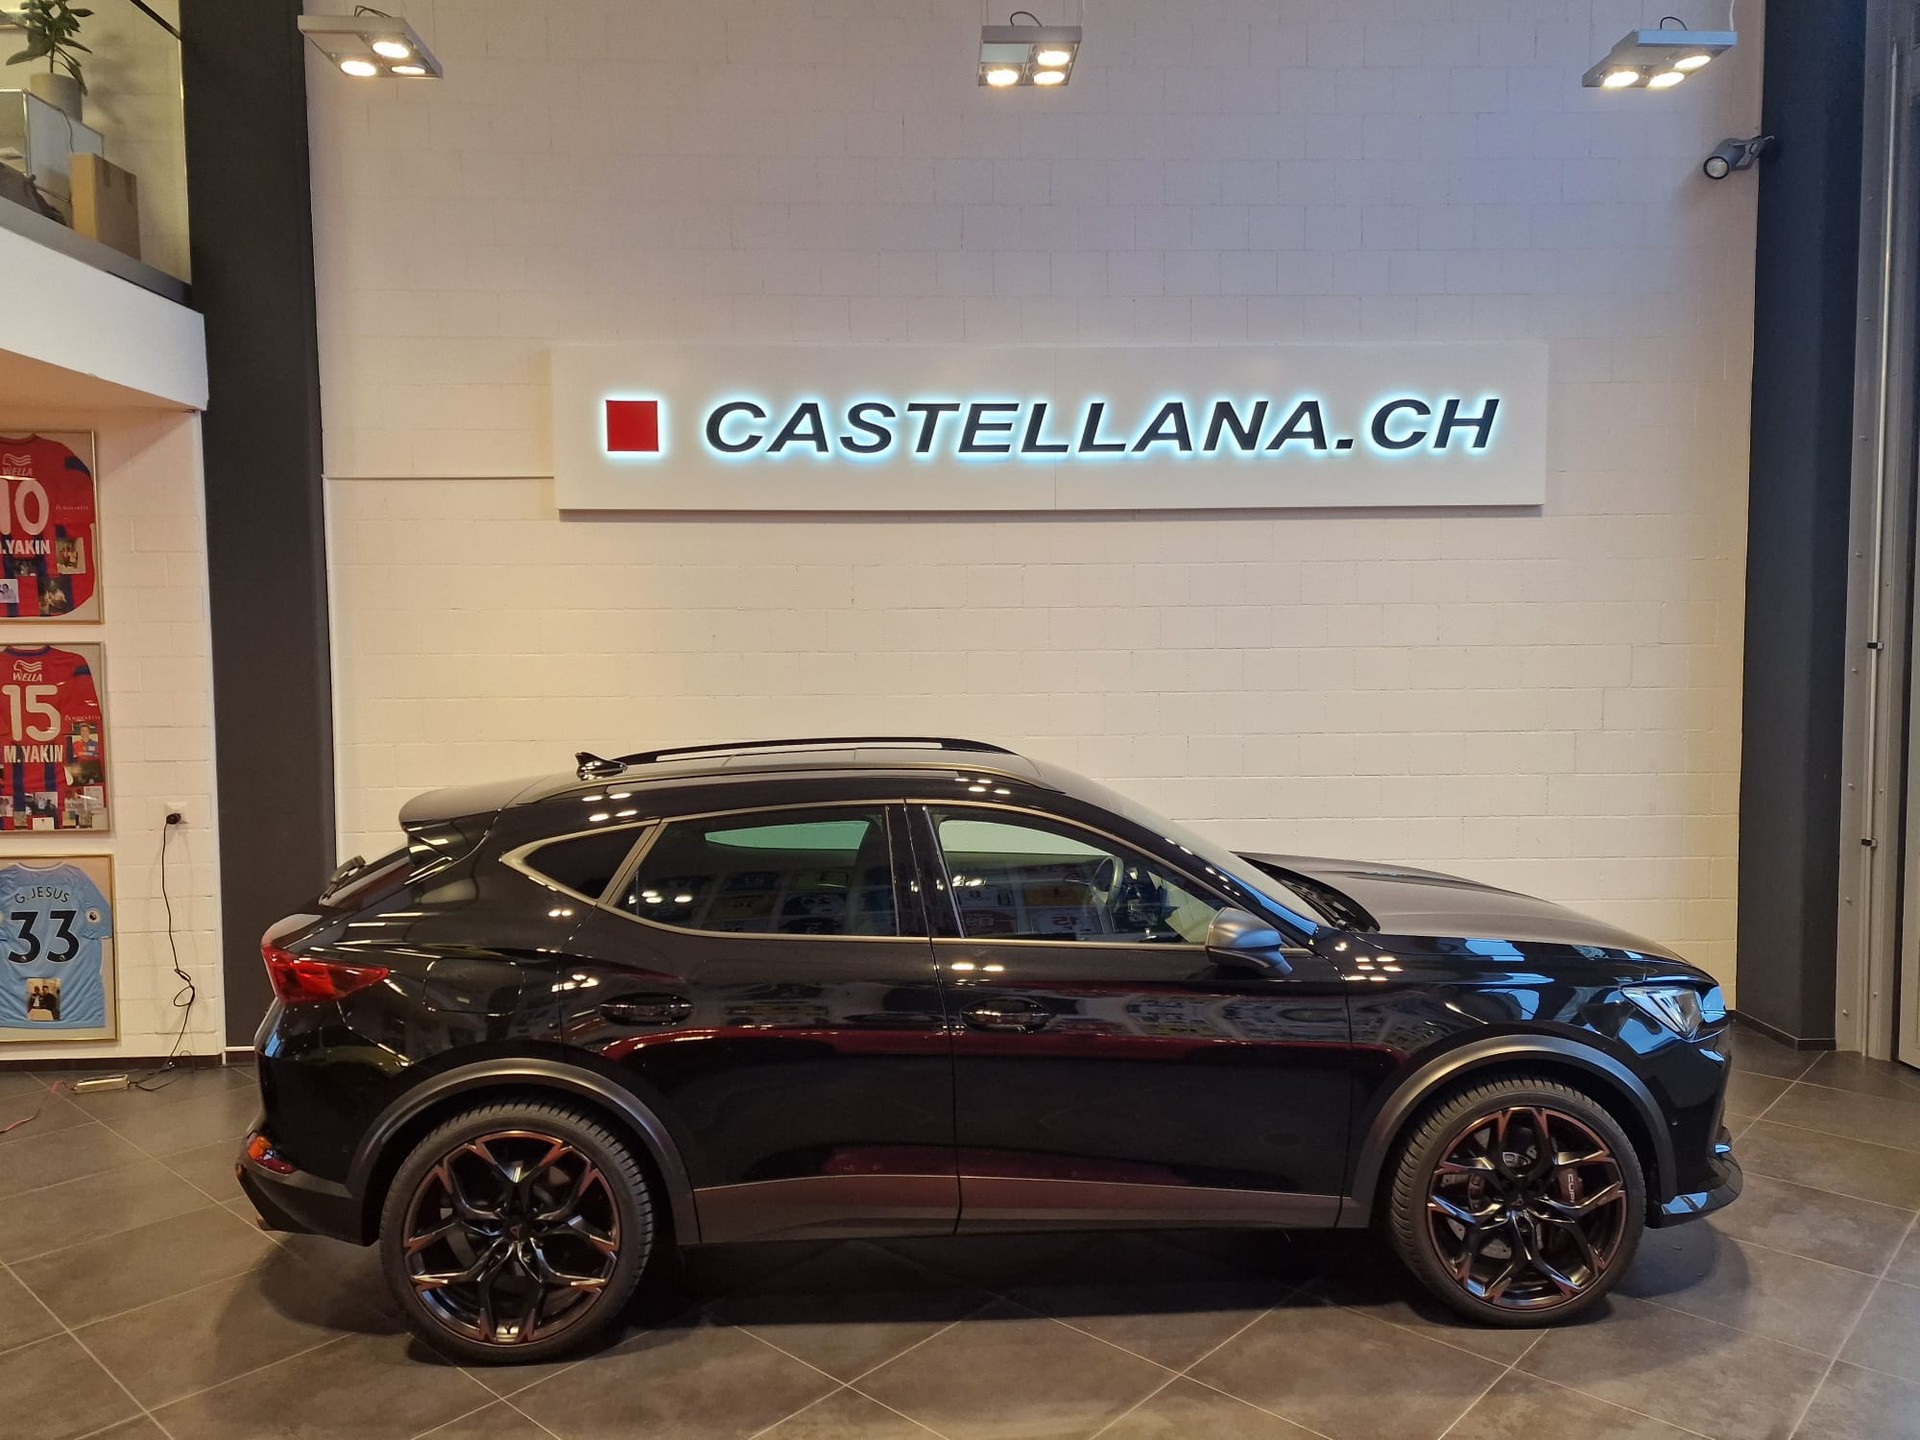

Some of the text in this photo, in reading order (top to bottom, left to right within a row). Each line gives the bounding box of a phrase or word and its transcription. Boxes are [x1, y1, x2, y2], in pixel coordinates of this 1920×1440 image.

[706, 398, 1500, 454] CASTELLANA.CH
[2, 467, 33, 477] WELLA
[0, 539, 51, 555] .YAKIN
[13, 672, 43, 682] WELLA
[2, 684, 61, 741] 15
[4, 744, 64, 763] M.YAKIN
[8, 910, 80, 964] 33
[1567, 1173, 1576, 1203] CUP
